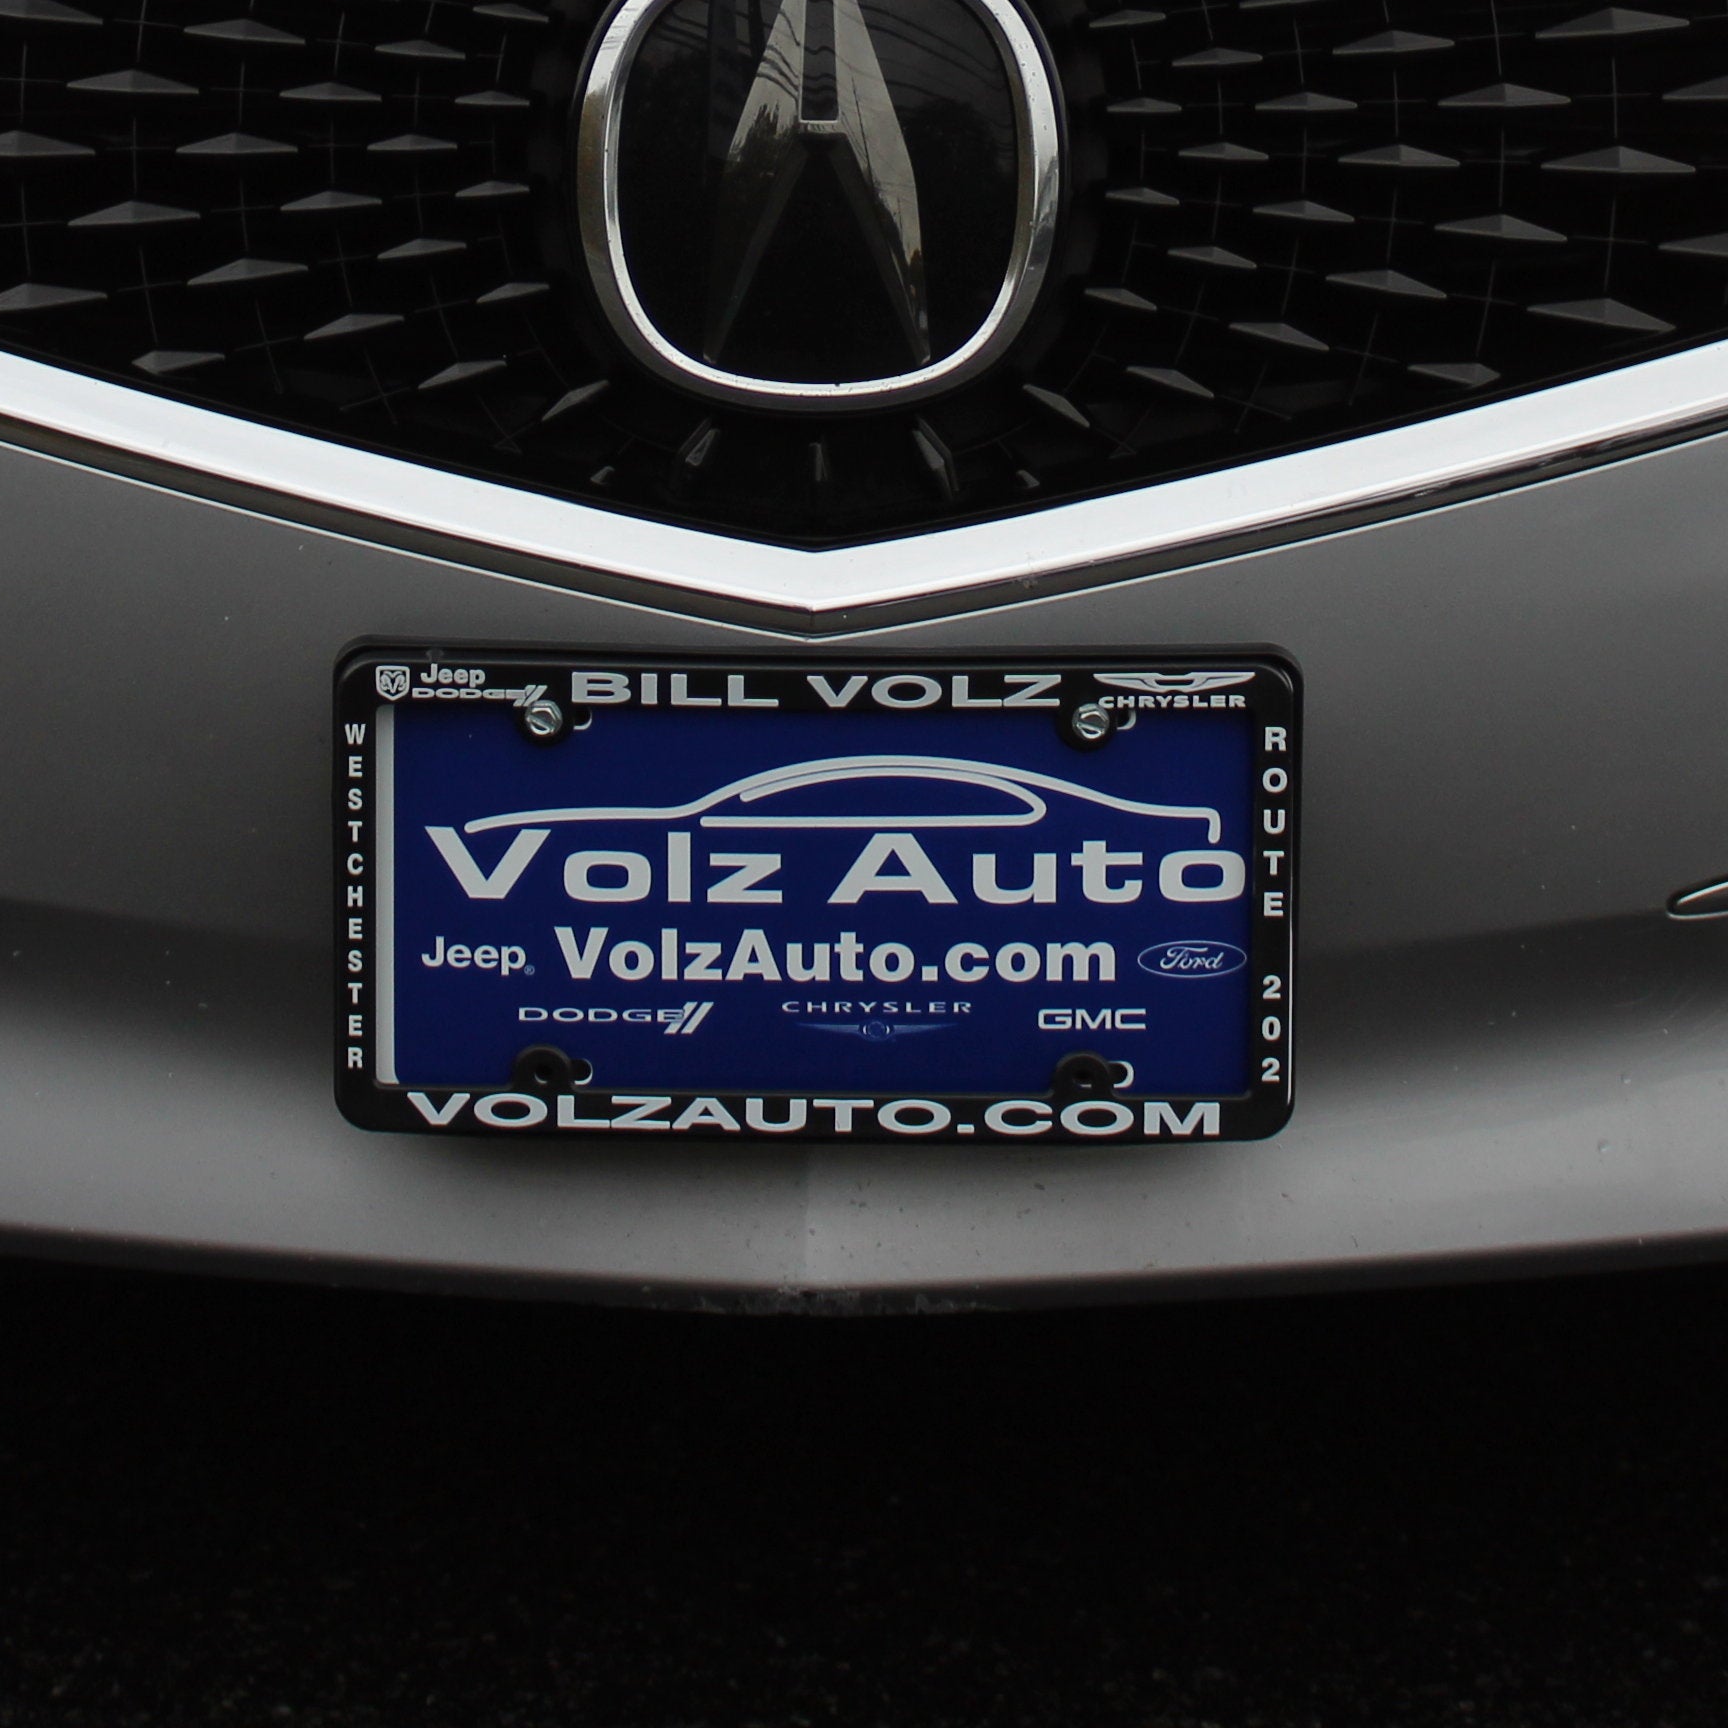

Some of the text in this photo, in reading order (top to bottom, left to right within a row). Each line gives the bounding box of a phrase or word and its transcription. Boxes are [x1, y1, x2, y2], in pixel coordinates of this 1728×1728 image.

[421, 663, 486, 688] Jeep
[412, 688, 528, 700] DODGE
[571, 672, 1061, 708] BILL VOLZ
[1098, 694, 1246, 708] CHRYSLER
[425, 827, 1247, 904] Volz Auto
[344, 723, 366, 1070] WESTCHESTER
[1262, 726, 1288, 1083] ROUTE 202
[553, 926, 1116, 983] VolzAuto.com
[1160, 946, 1225, 970] Ford
[518, 1006, 684, 1024] DODGE
[781, 1000, 973, 1015] CHRYSLER
[1037, 1008, 1147, 1030] GMC
[407, 1093, 1221, 1135] VOLZAUTO.COM
